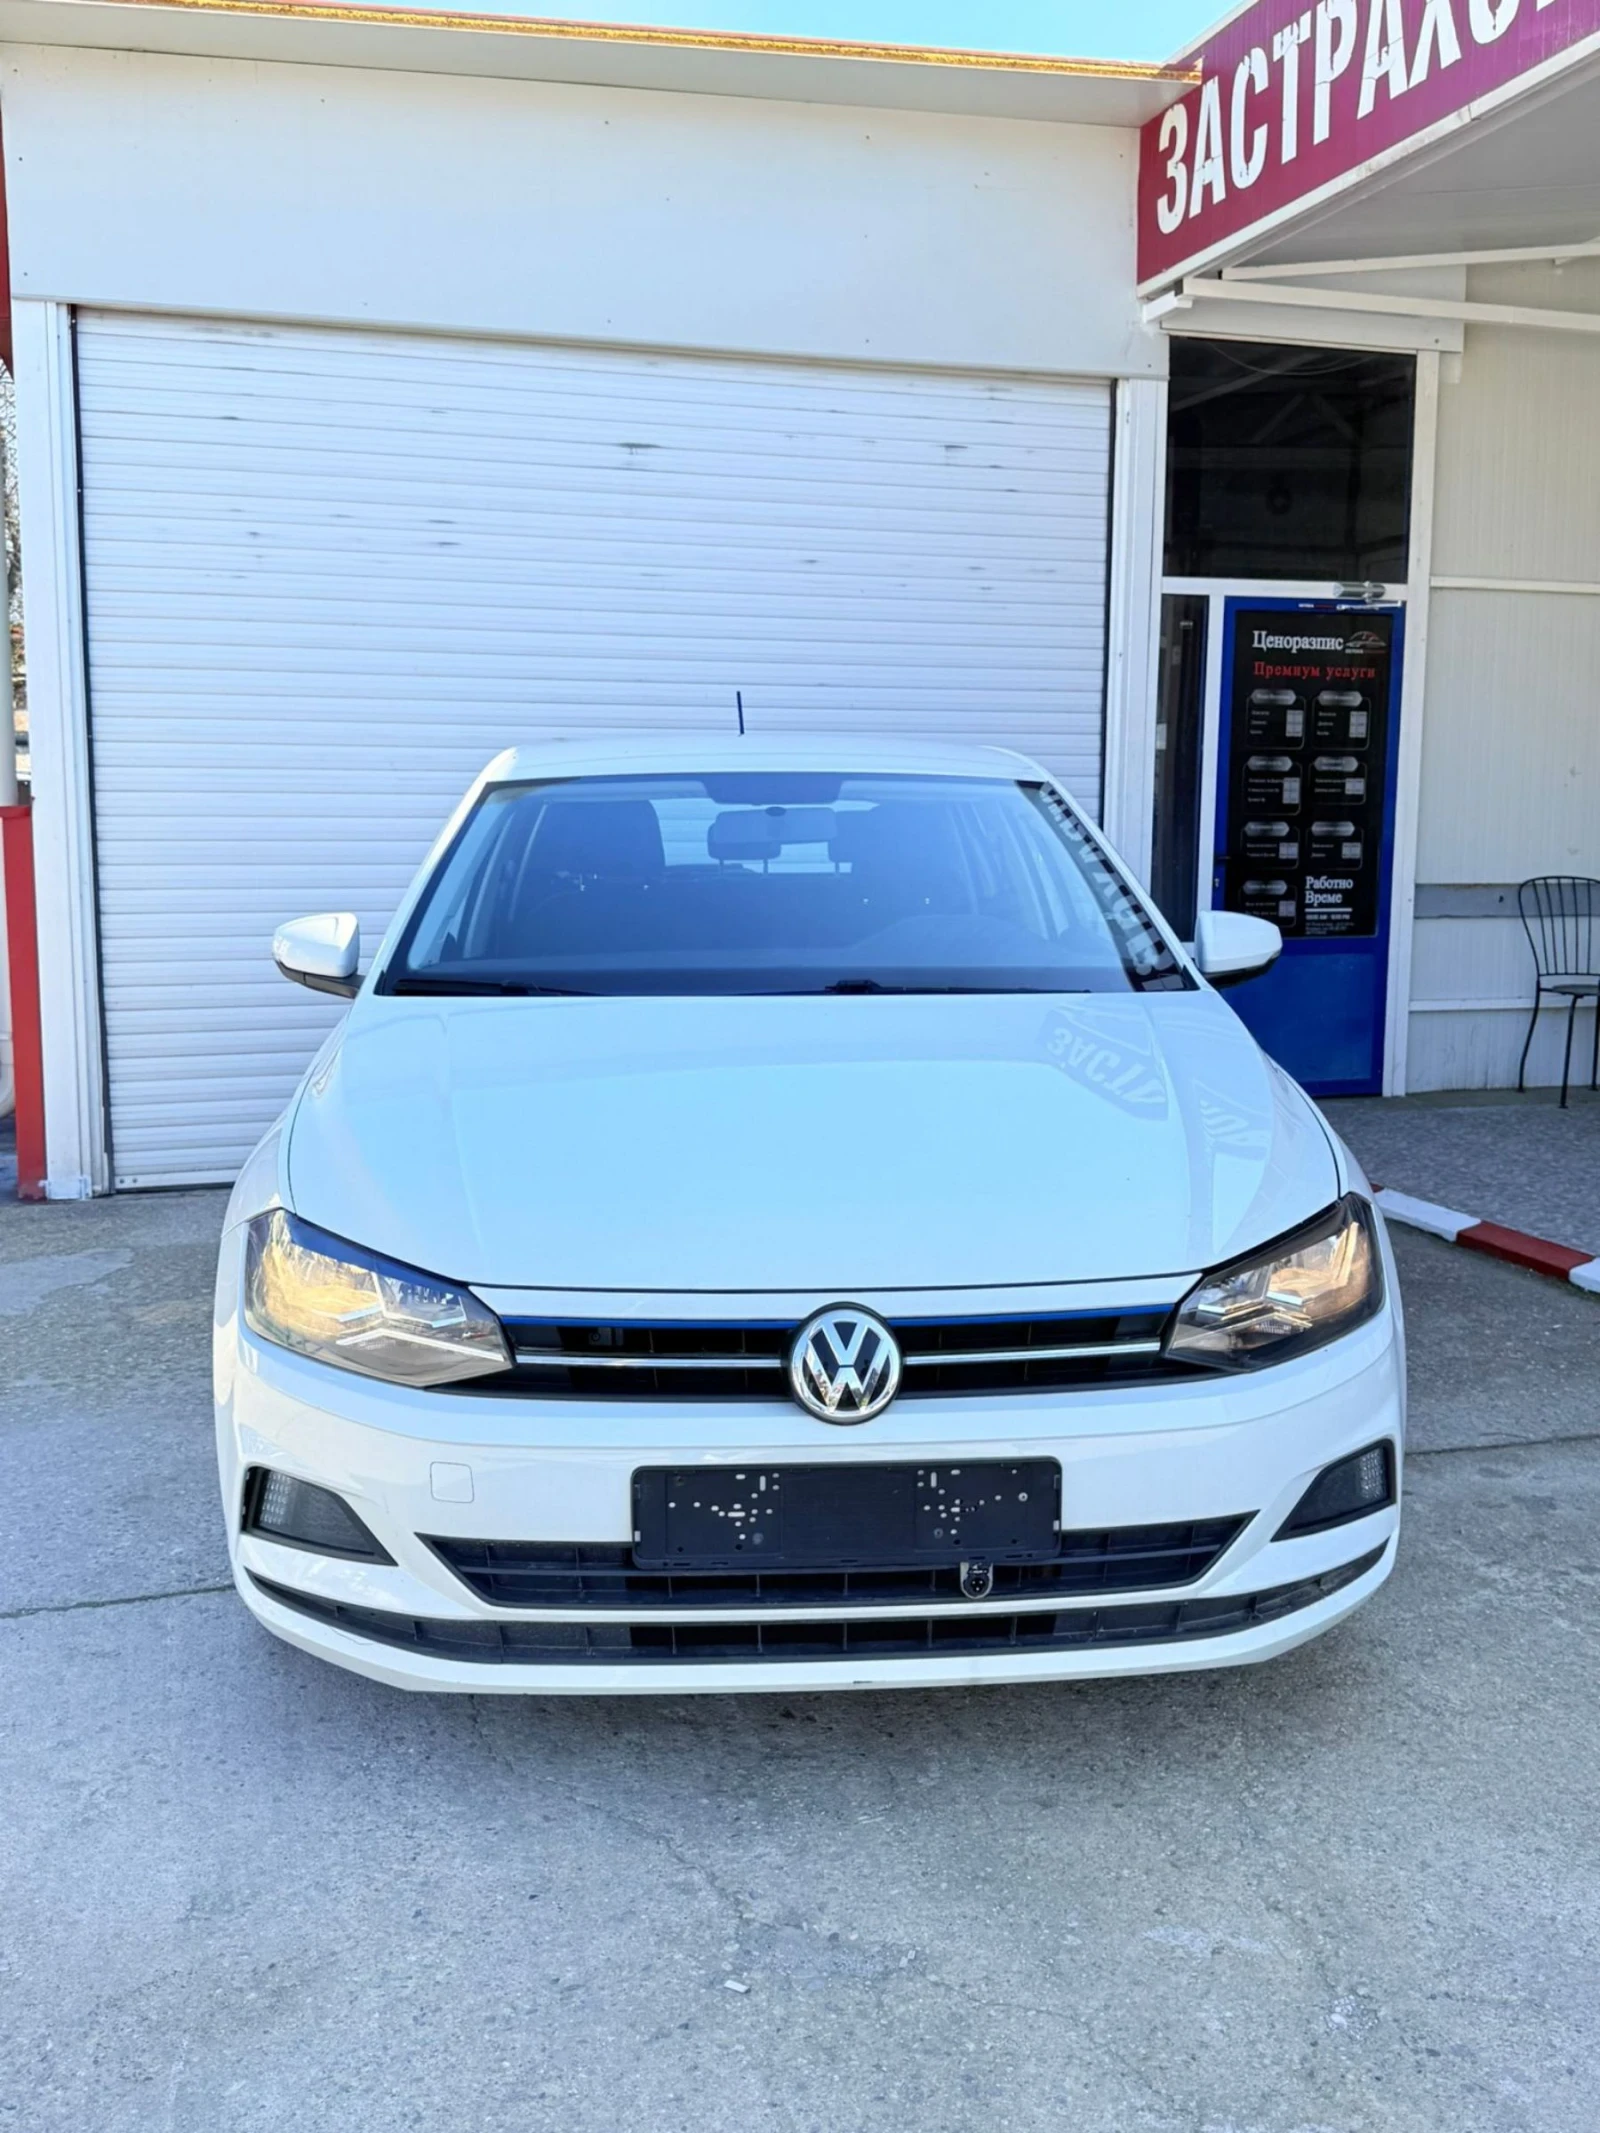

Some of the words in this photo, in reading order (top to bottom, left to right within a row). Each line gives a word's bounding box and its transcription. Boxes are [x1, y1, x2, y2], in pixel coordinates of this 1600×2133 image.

[1157, 0, 1557, 235] ЗАСТРАХ
[1252, 630, 1344, 654] Ценоразпис
[1254, 661, 1320, 680] Премиум
[1326, 665, 1376, 681] услуги
[1305, 875, 1353, 889] Работно
[1304, 890, 1343, 907] Време
[801, 1316, 893, 1414] VW
